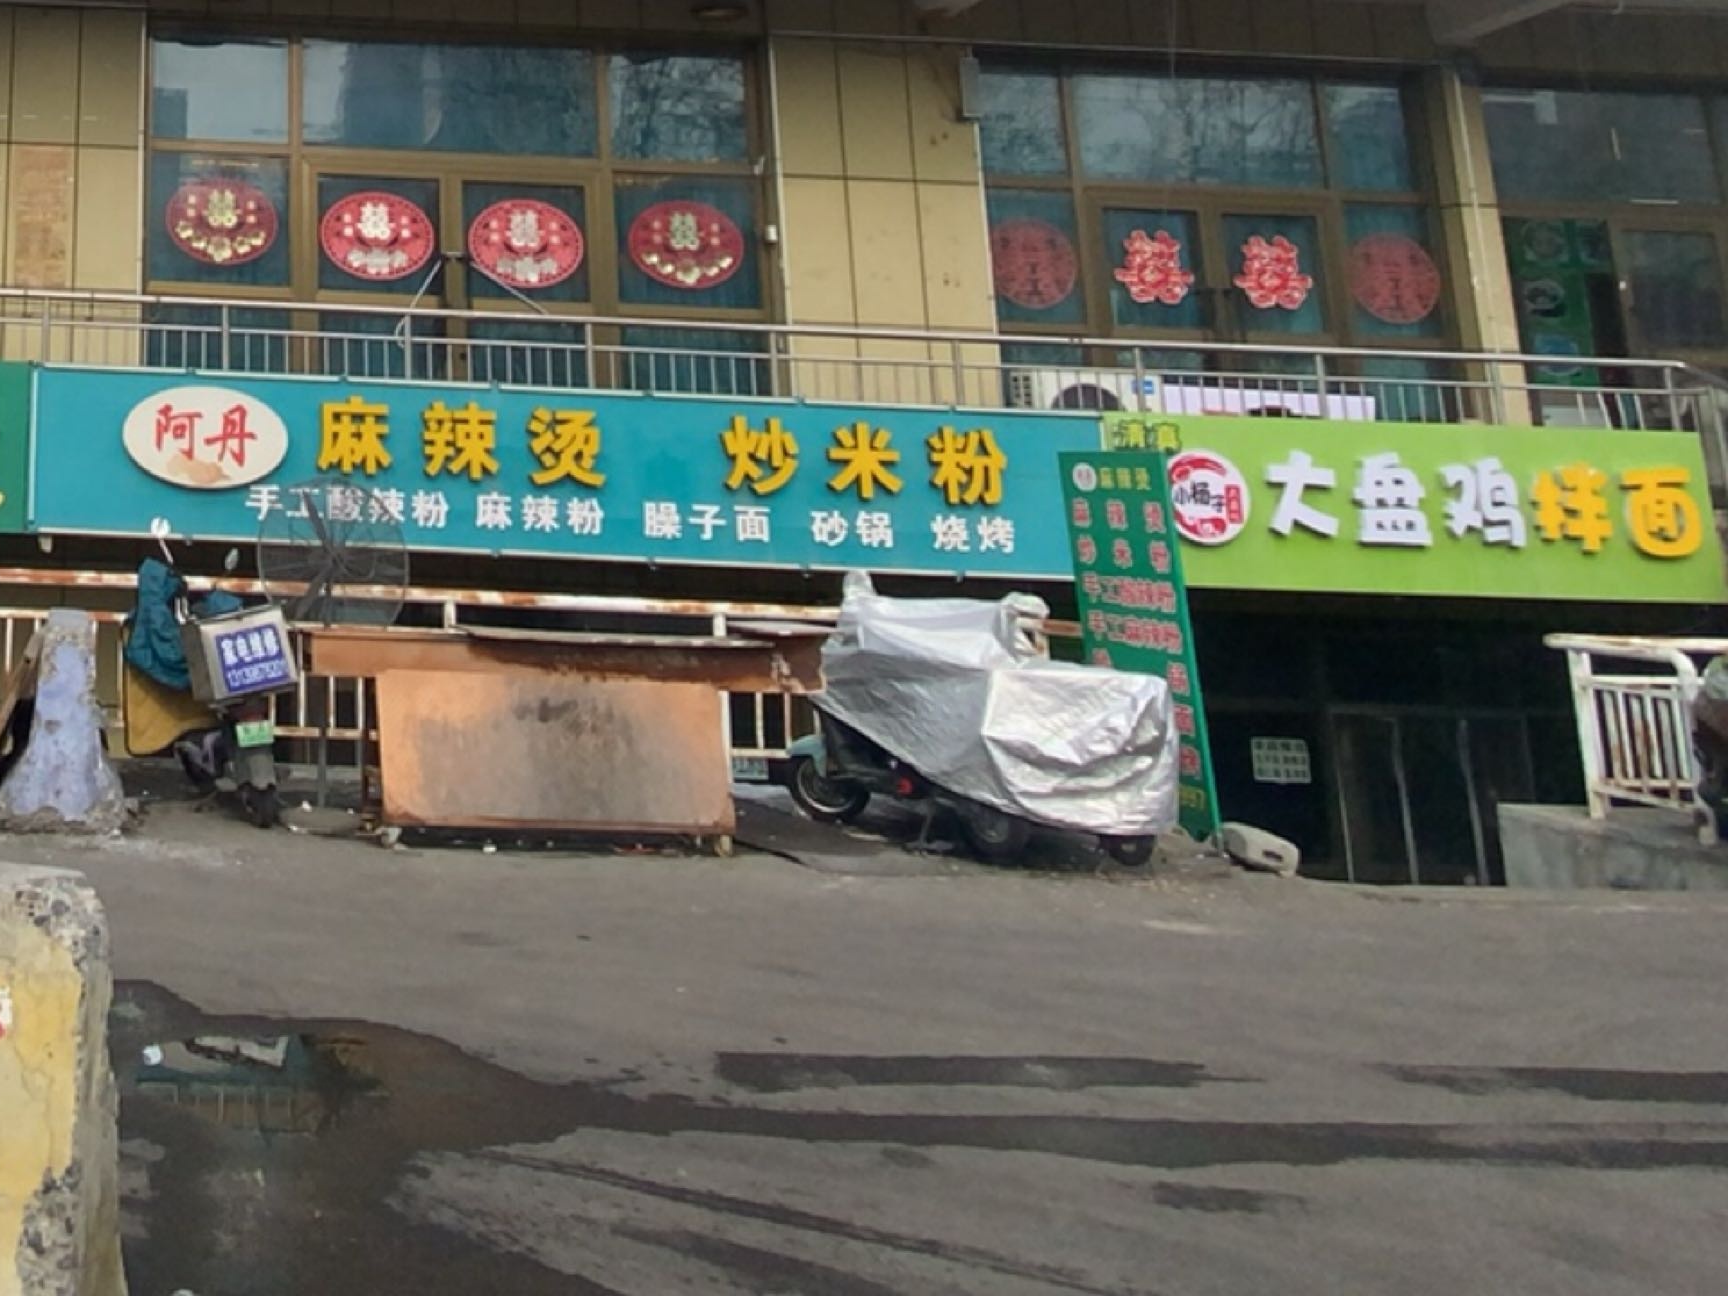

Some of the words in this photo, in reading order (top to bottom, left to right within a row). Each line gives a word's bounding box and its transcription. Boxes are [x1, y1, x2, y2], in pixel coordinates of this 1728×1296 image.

[154, 403, 258, 468] 阿丹
[316, 397, 608, 490] 麻辣烫
[721, 414, 1009, 507] 炒米粉
[1262, 448, 1703, 558] 大盘鸡拌面
[244, 483, 450, 529] 手工酸辣粉
[475, 492, 606, 534] 麻辣粉
[643, 502, 771, 543] 臊子面
[810, 510, 895, 548] 砂锅
[931, 514, 1016, 554] 烧烤
